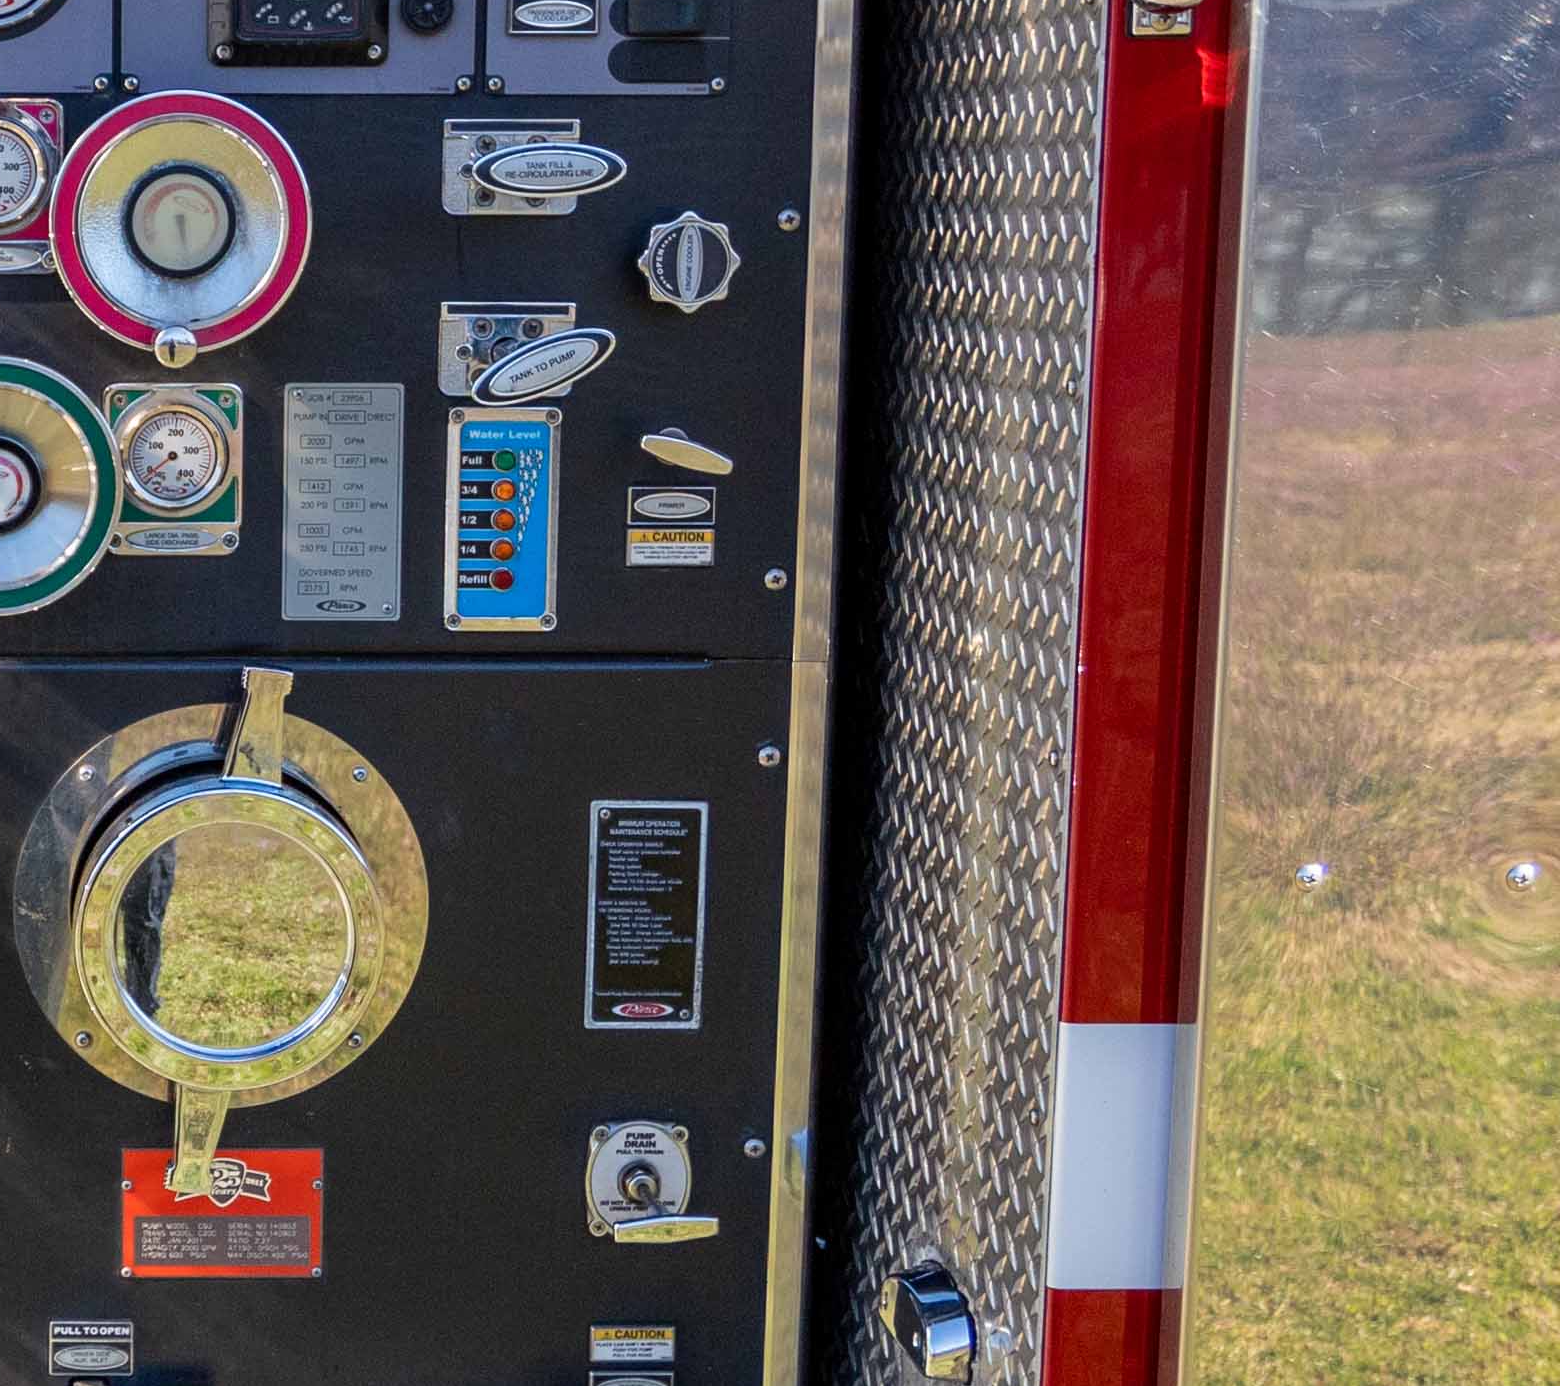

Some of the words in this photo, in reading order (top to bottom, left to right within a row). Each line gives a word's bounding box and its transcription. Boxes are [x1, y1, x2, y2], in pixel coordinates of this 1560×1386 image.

[2, 163, 19, 171] 300
[504, 169, 573, 179] RE-CIRCULATING
[575, 169, 594, 177] LINE
[686, 234, 694, 265] COOLER
[656, 248, 664, 276] OPEN
[685, 266, 693, 292] ENGINE
[509, 368, 535, 384] TANK
[534, 362, 547, 374] TO
[548, 349, 576, 369] PUMP
[335, 413, 359, 421] DRIVE
[168, 429, 184, 437] 200
[469, 429, 504, 439] Water
[509, 429, 541, 439] Level
[148, 442, 164, 450] 100
[183, 446, 199, 455] 300
[462, 456, 482, 465] Full
[461, 485, 478, 495] 3/4
[461, 516, 477, 525] 1/2
[652, 532, 705, 542] CAUTION
[460, 545, 476, 554] 1/4
[459, 574, 487, 584] Refill
[54, 1327, 82, 1335] PULL
[84, 1327, 99, 1335] TO
[100, 1327, 130, 1335] OPEN
[615, 1330, 665, 1339] CAUTION
